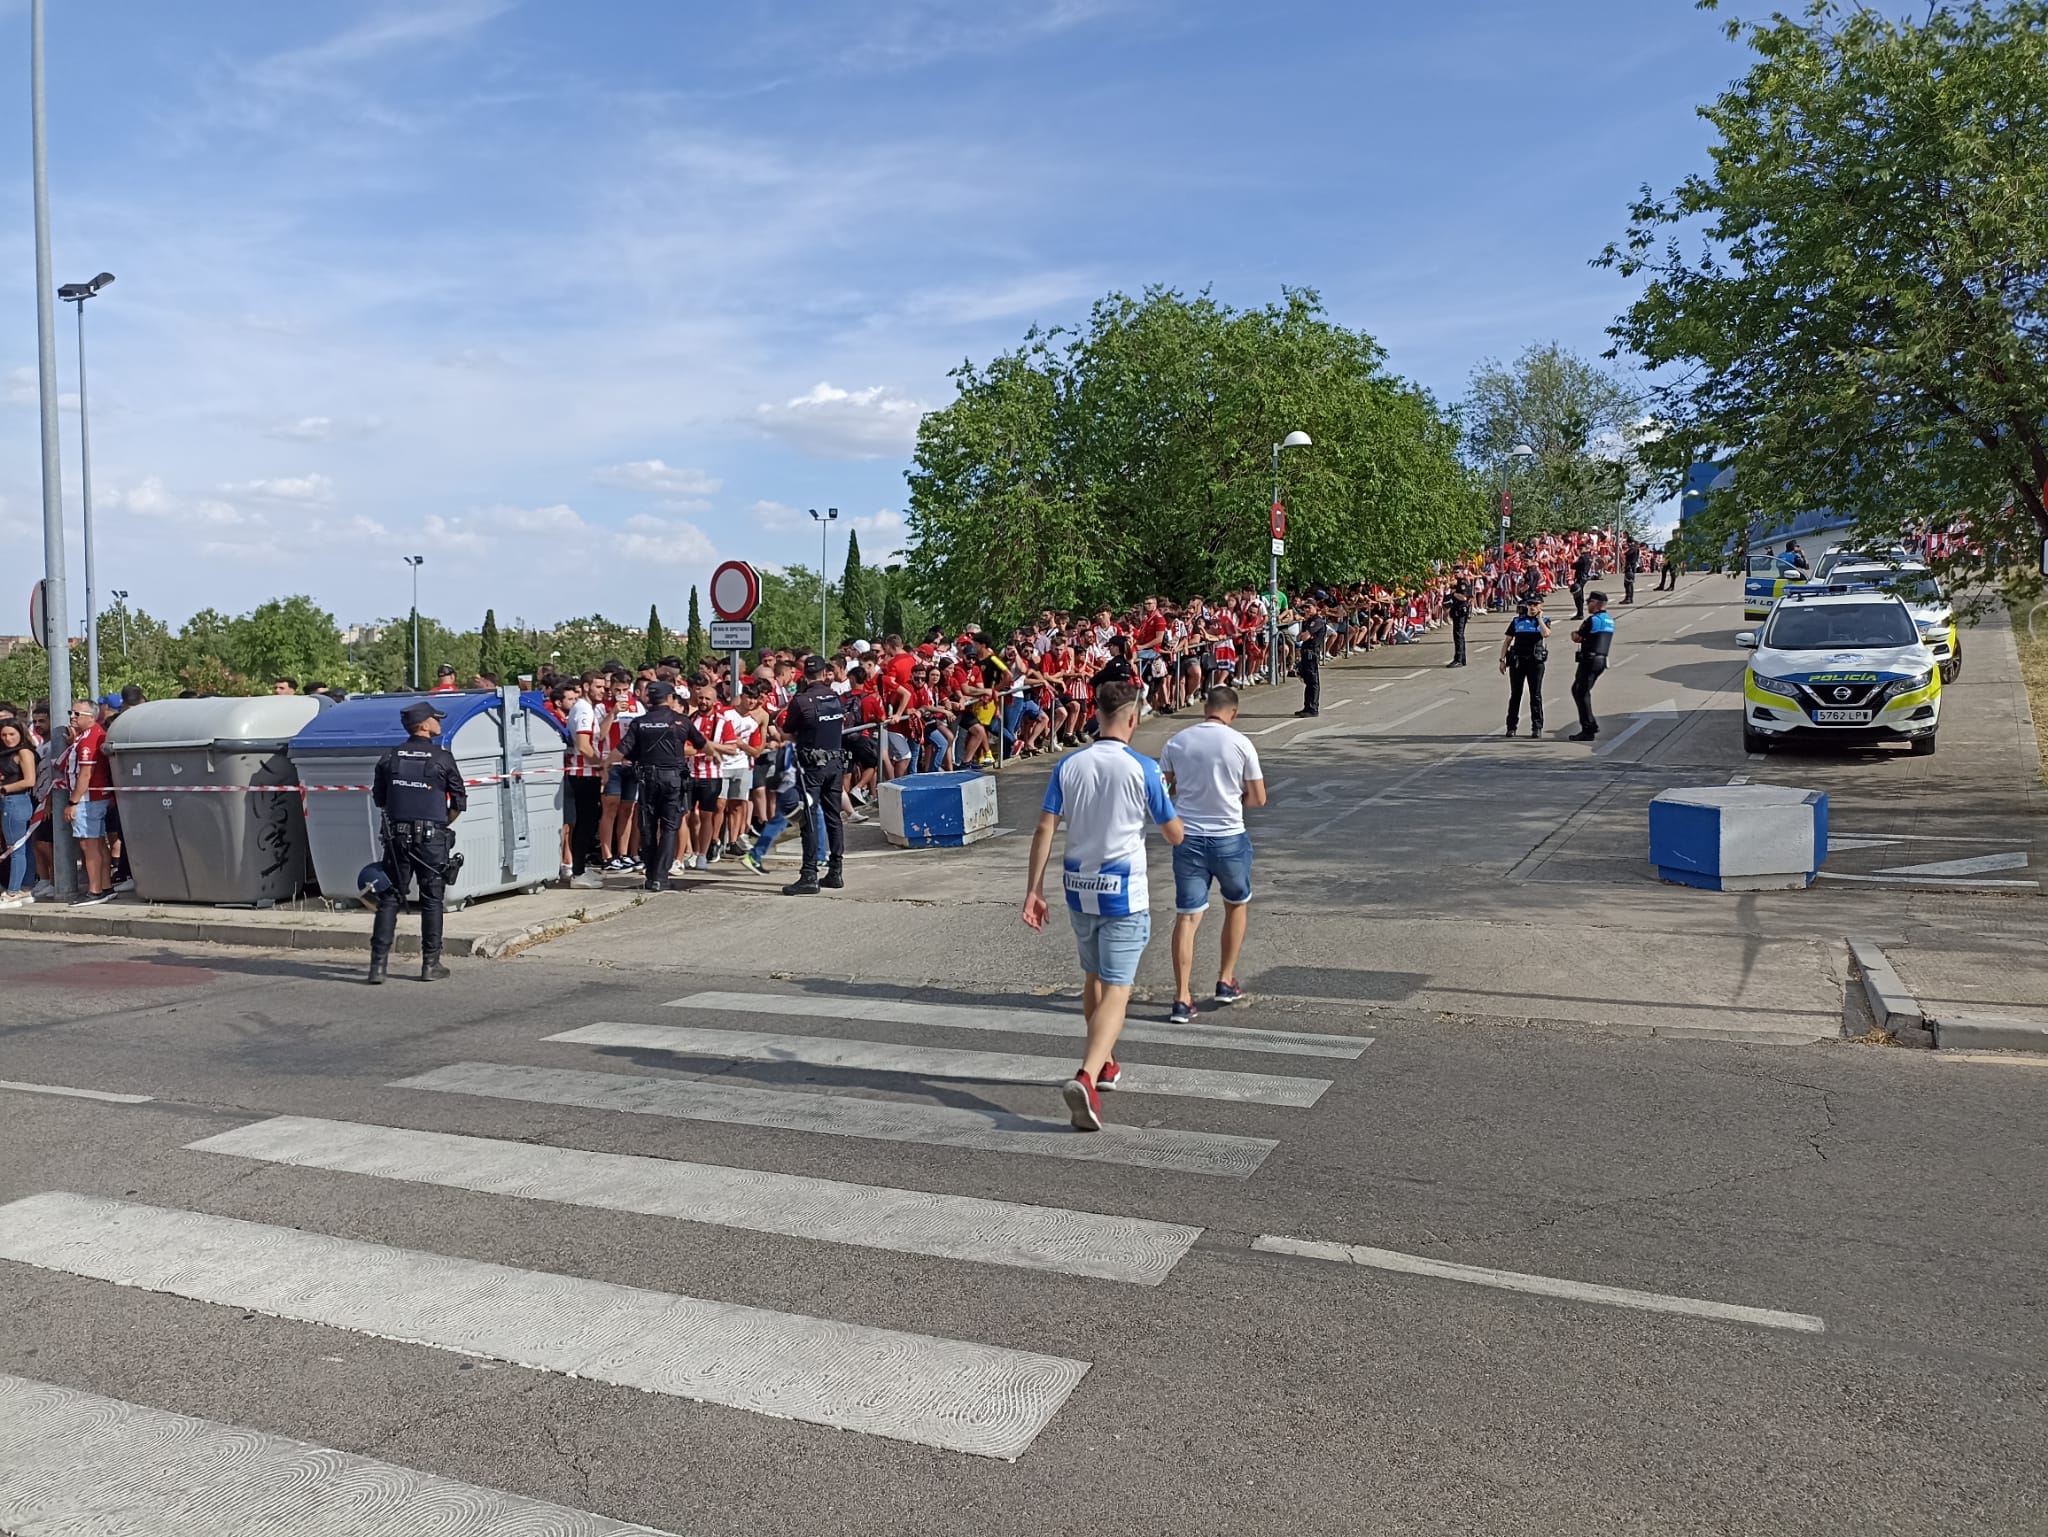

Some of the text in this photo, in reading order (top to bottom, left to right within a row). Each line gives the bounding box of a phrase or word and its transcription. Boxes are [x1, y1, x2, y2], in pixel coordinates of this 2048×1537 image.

[1808, 673, 1877, 682] POLICÍA
[1819, 711, 1846, 720] 5762
[392, 779, 428, 788] POLICIA
